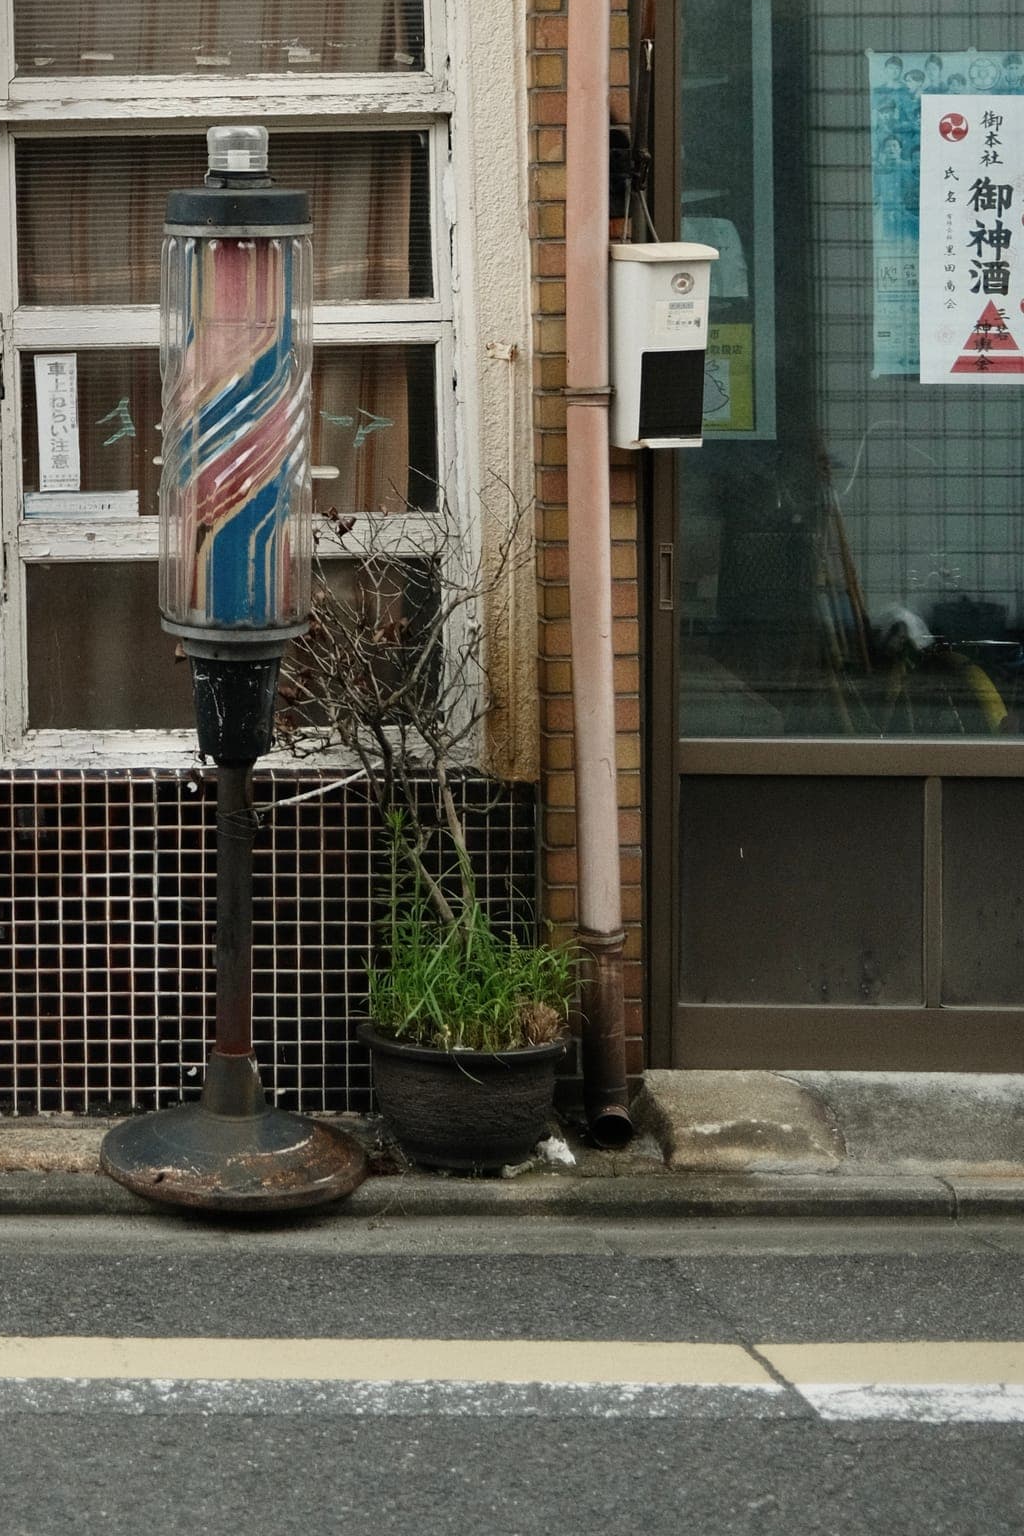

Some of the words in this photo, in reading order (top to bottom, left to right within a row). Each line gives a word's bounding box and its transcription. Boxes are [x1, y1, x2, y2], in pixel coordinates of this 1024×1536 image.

[980, 110, 1004, 167] 御本社
[943, 166, 959, 203] 氏名
[966, 176, 1014, 296] 御神酒
[943, 244, 957, 309] 黒田商会
[47, 361, 70, 470] 車上ねらい注意
